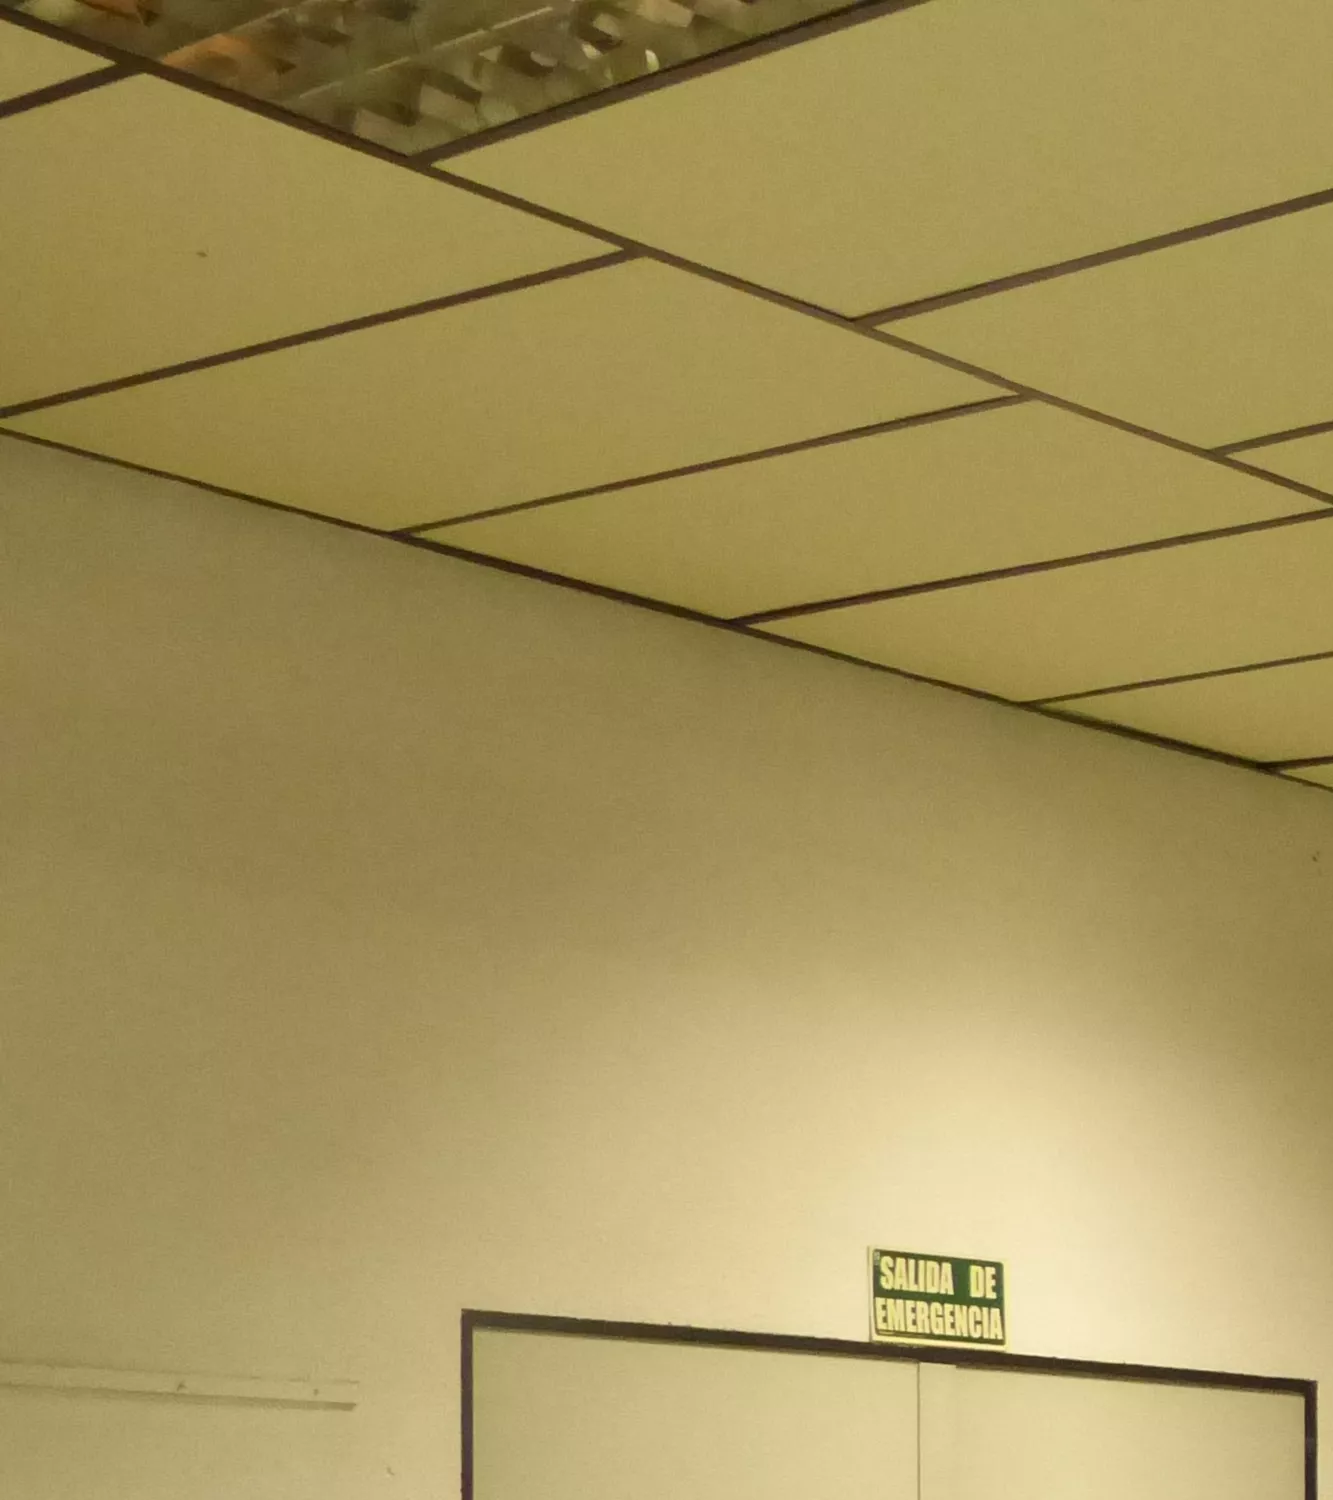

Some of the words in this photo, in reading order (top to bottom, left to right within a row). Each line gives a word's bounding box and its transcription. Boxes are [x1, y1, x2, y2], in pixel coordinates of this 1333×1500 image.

[880, 1256, 954, 1295] SALIDA
[970, 1265, 997, 1299] DE
[875, 1297, 1003, 1340] EMERGENCIA
